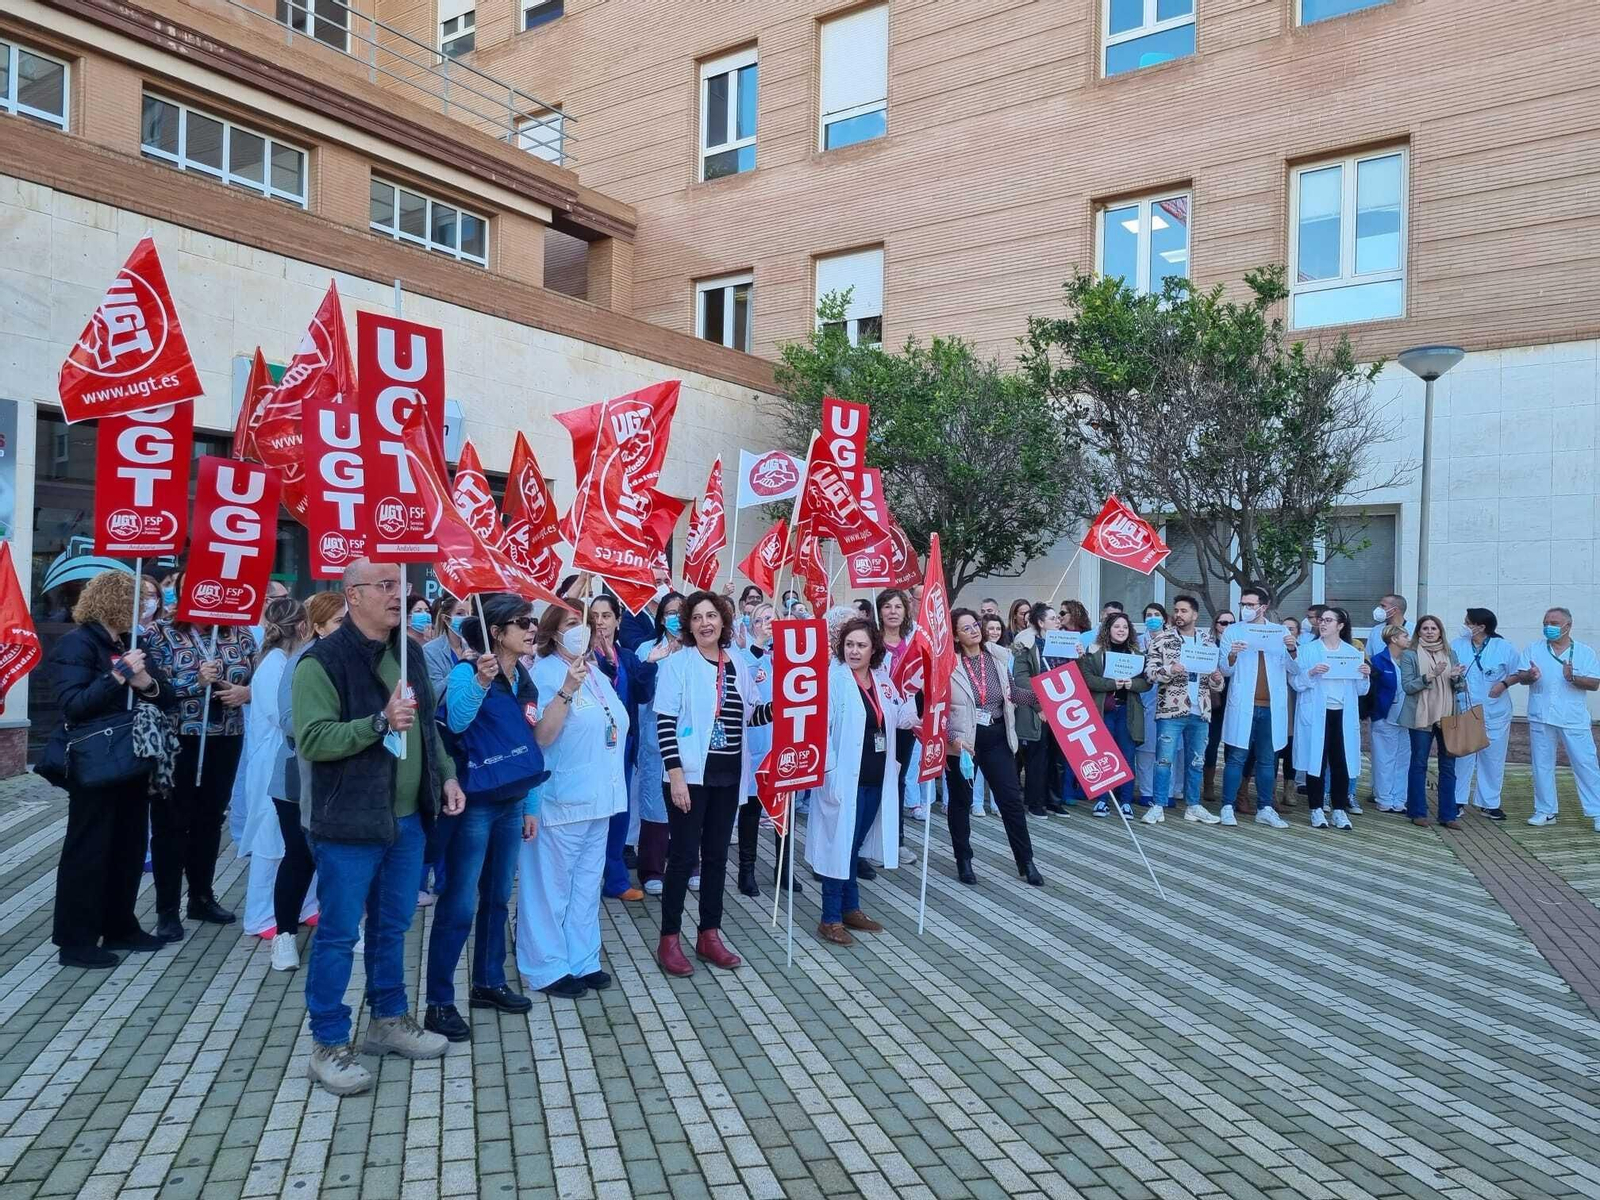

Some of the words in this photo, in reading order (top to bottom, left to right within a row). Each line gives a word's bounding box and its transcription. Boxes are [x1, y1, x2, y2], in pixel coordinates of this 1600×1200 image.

[102, 278, 155, 357] UGT
[81, 373, 180, 405] www.ugt.es
[376, 327, 428, 494] UGT
[611, 407, 652, 446] UGT
[830, 406, 860, 480] UG
[319, 409, 365, 531] UGT
[758, 458, 790, 474] UGT
[814, 466, 859, 520] UGT
[111, 514, 138, 527] UGT
[144, 516, 163, 526] FSP
[209, 466, 266, 580] UGT
[379, 504, 403, 519] UGT
[1108, 513, 1148, 541] UGT
[323, 537, 344, 551] UGT
[350, 539, 365, 549] FSP
[595, 546, 652, 568] .ugt.es
[196, 584, 221, 597] UGT
[226, 587, 244, 597] FSP
[783, 628, 818, 743] UGT
[1041, 670, 1098, 756] UGT
[780, 751, 796, 766] UGT
[799, 750, 810, 760] FSP
